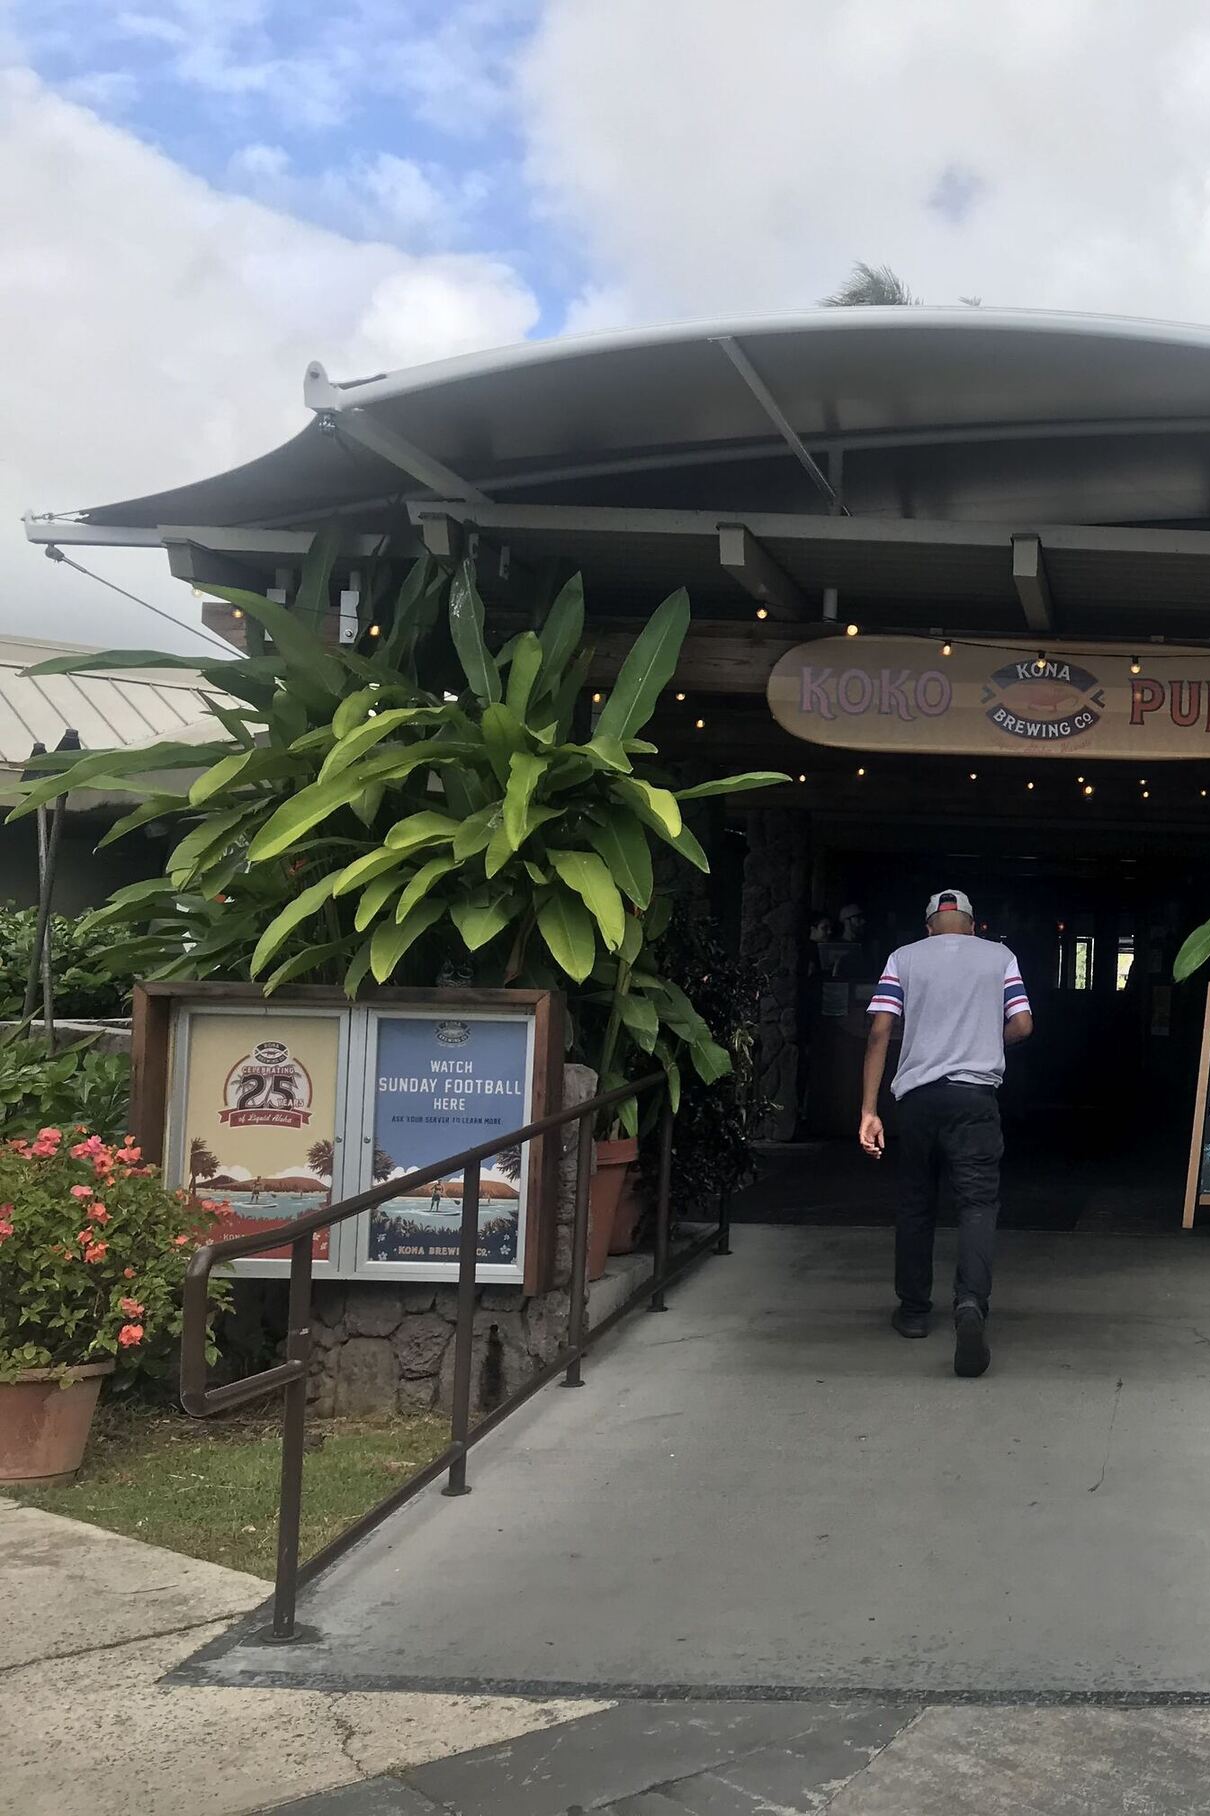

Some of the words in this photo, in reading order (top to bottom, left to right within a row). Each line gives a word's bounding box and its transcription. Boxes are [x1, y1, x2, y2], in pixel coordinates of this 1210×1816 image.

[1017, 662, 1071, 681] KONA
[800, 665, 953, 721] KOKO
[993, 709, 1071, 738] BREWING
[241, 1065, 295, 1075] CELEBRATING
[430, 1060, 473, 1073] WATCH
[238, 1073, 299, 1110] 25
[379, 1077, 438, 1093] SUNDAY
[445, 1079, 522, 1095] FOOTBALL
[434, 1098, 466, 1111] HERE
[399, 1246, 424, 1255] KONA
